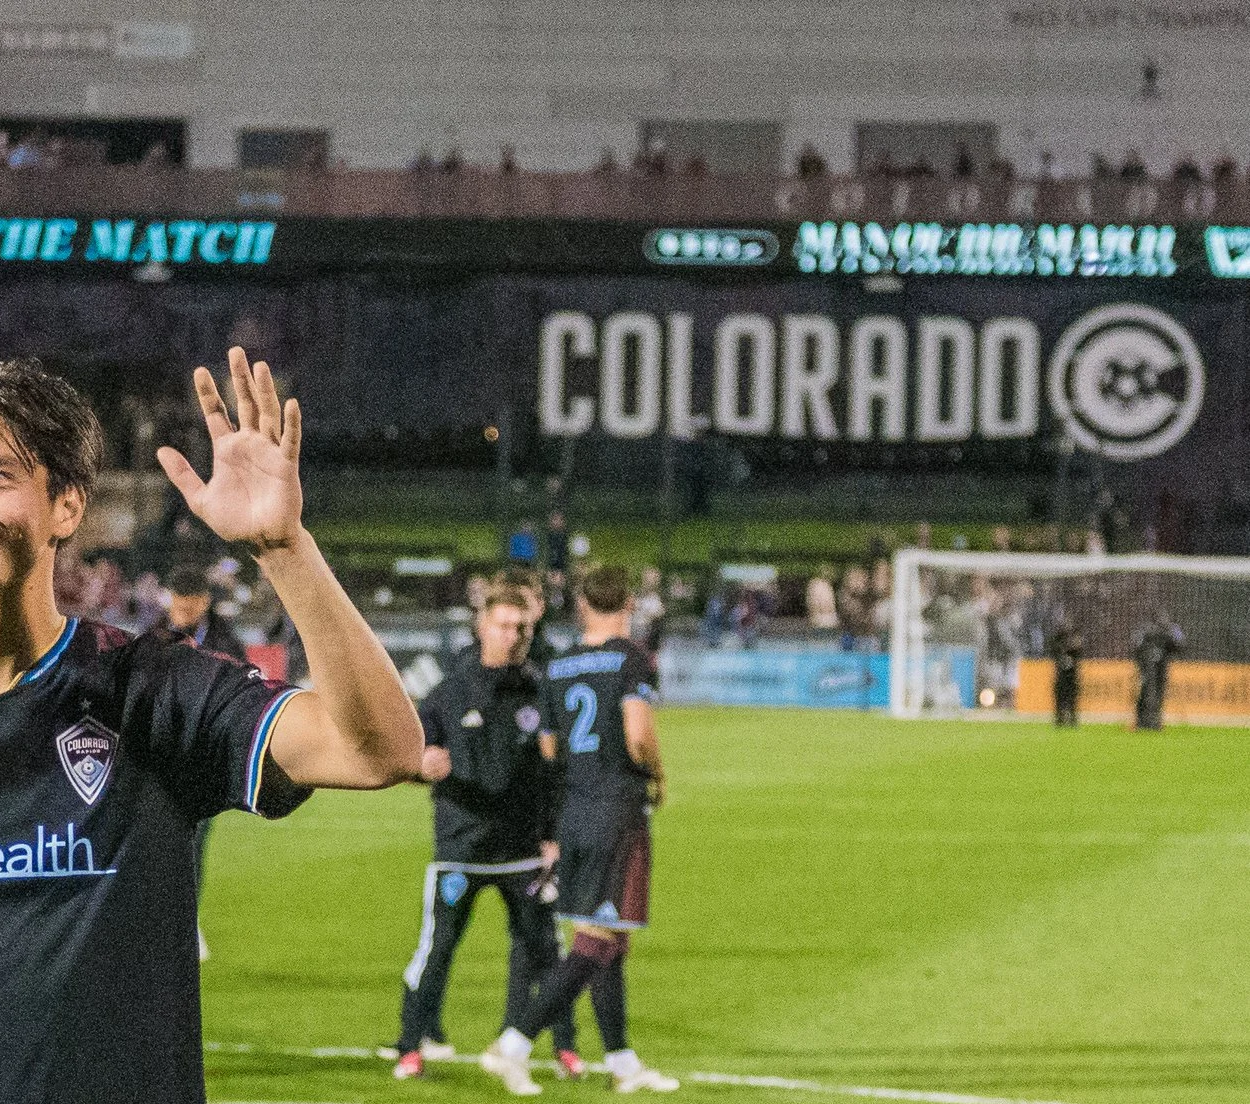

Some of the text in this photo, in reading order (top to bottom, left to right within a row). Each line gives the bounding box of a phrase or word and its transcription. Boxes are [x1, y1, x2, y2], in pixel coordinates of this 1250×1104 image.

[85, 219, 277, 264] MATCH
[538, 311, 1043, 442] COLORADO
[67, 737, 109, 752] COLORADO
[565, 682, 600, 754] 2
